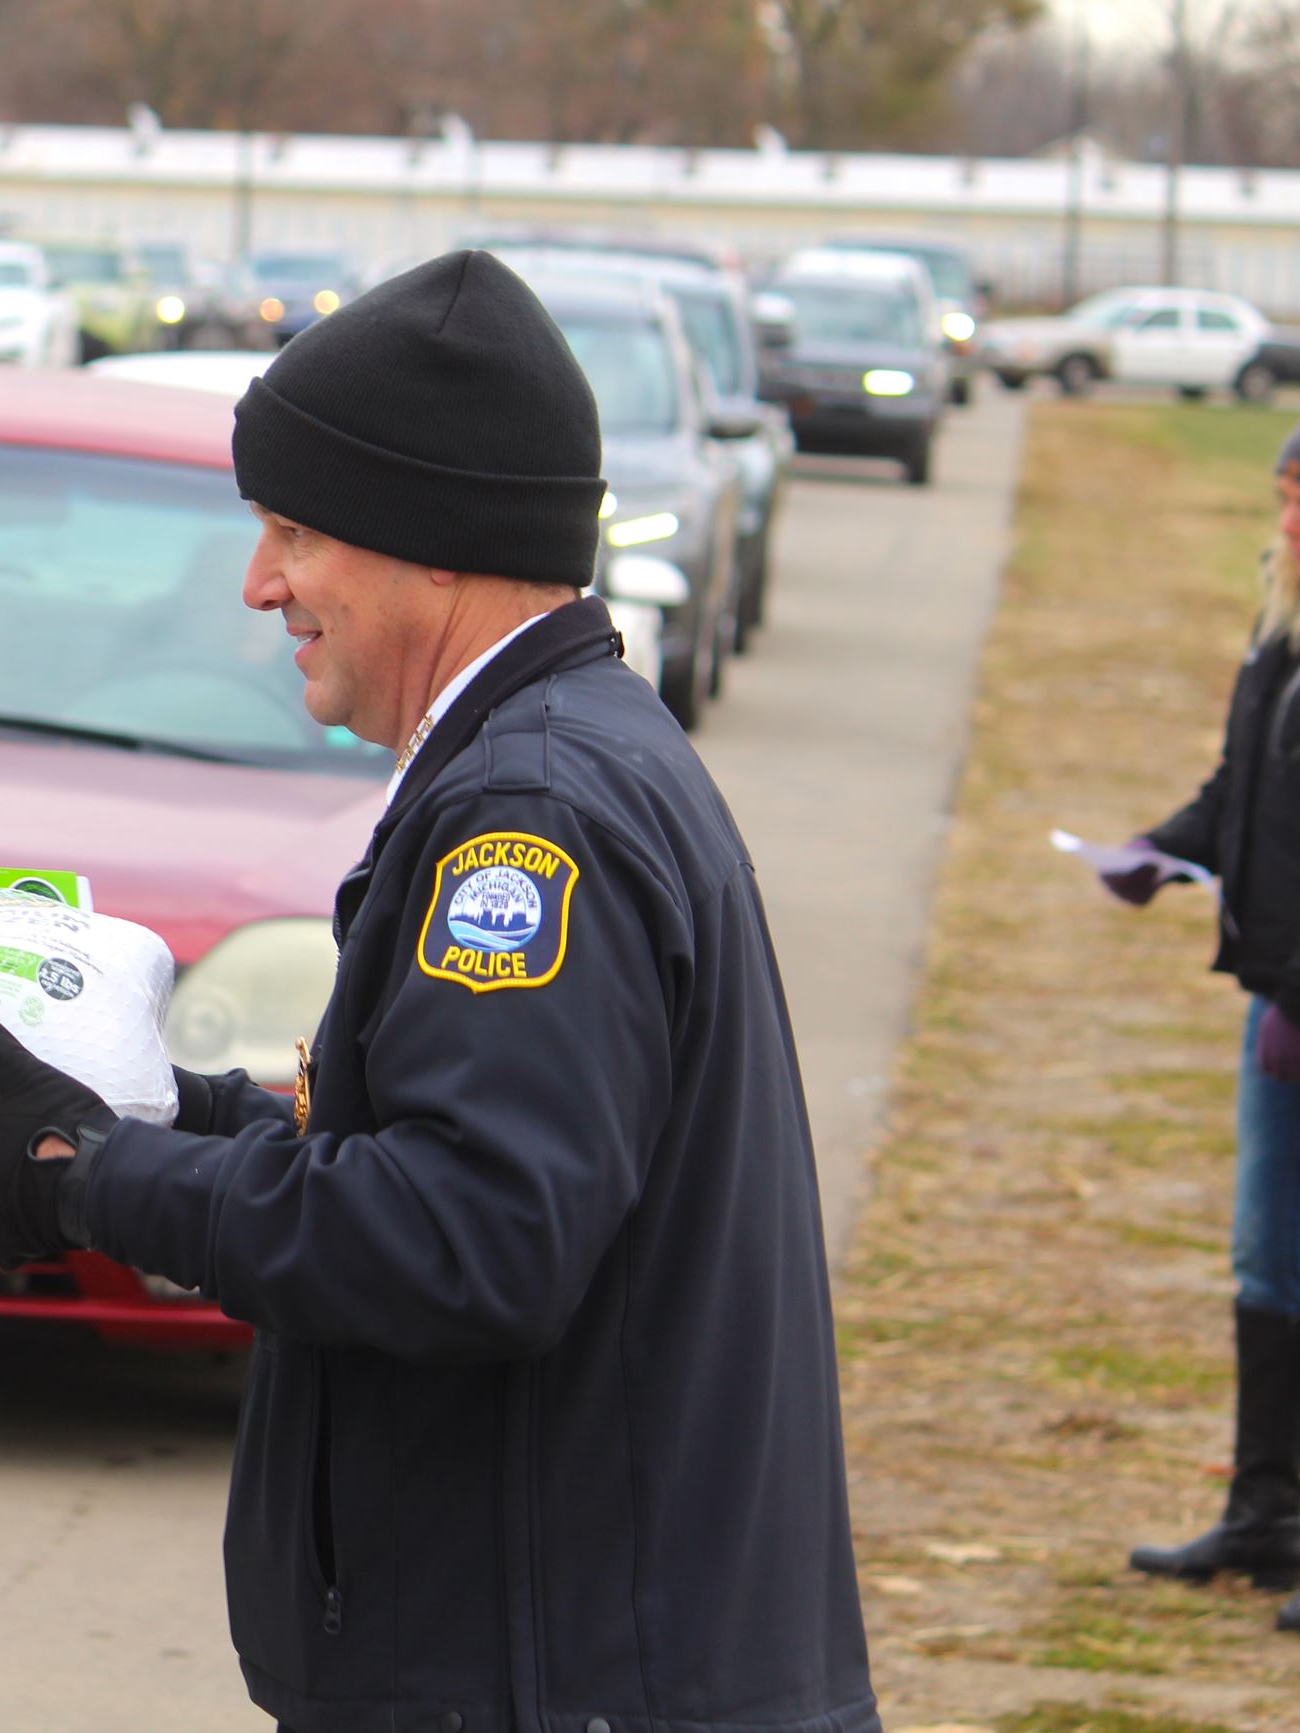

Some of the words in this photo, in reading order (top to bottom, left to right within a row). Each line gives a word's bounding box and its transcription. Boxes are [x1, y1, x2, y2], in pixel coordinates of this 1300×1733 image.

[452, 841, 560, 879] JACKSON
[454, 881, 472, 905] CITY
[476, 870, 491, 882] OF
[495, 869, 538, 908] JACKSON
[469, 881, 524, 903] MICHIGAN
[441, 945, 527, 977] POLICE
